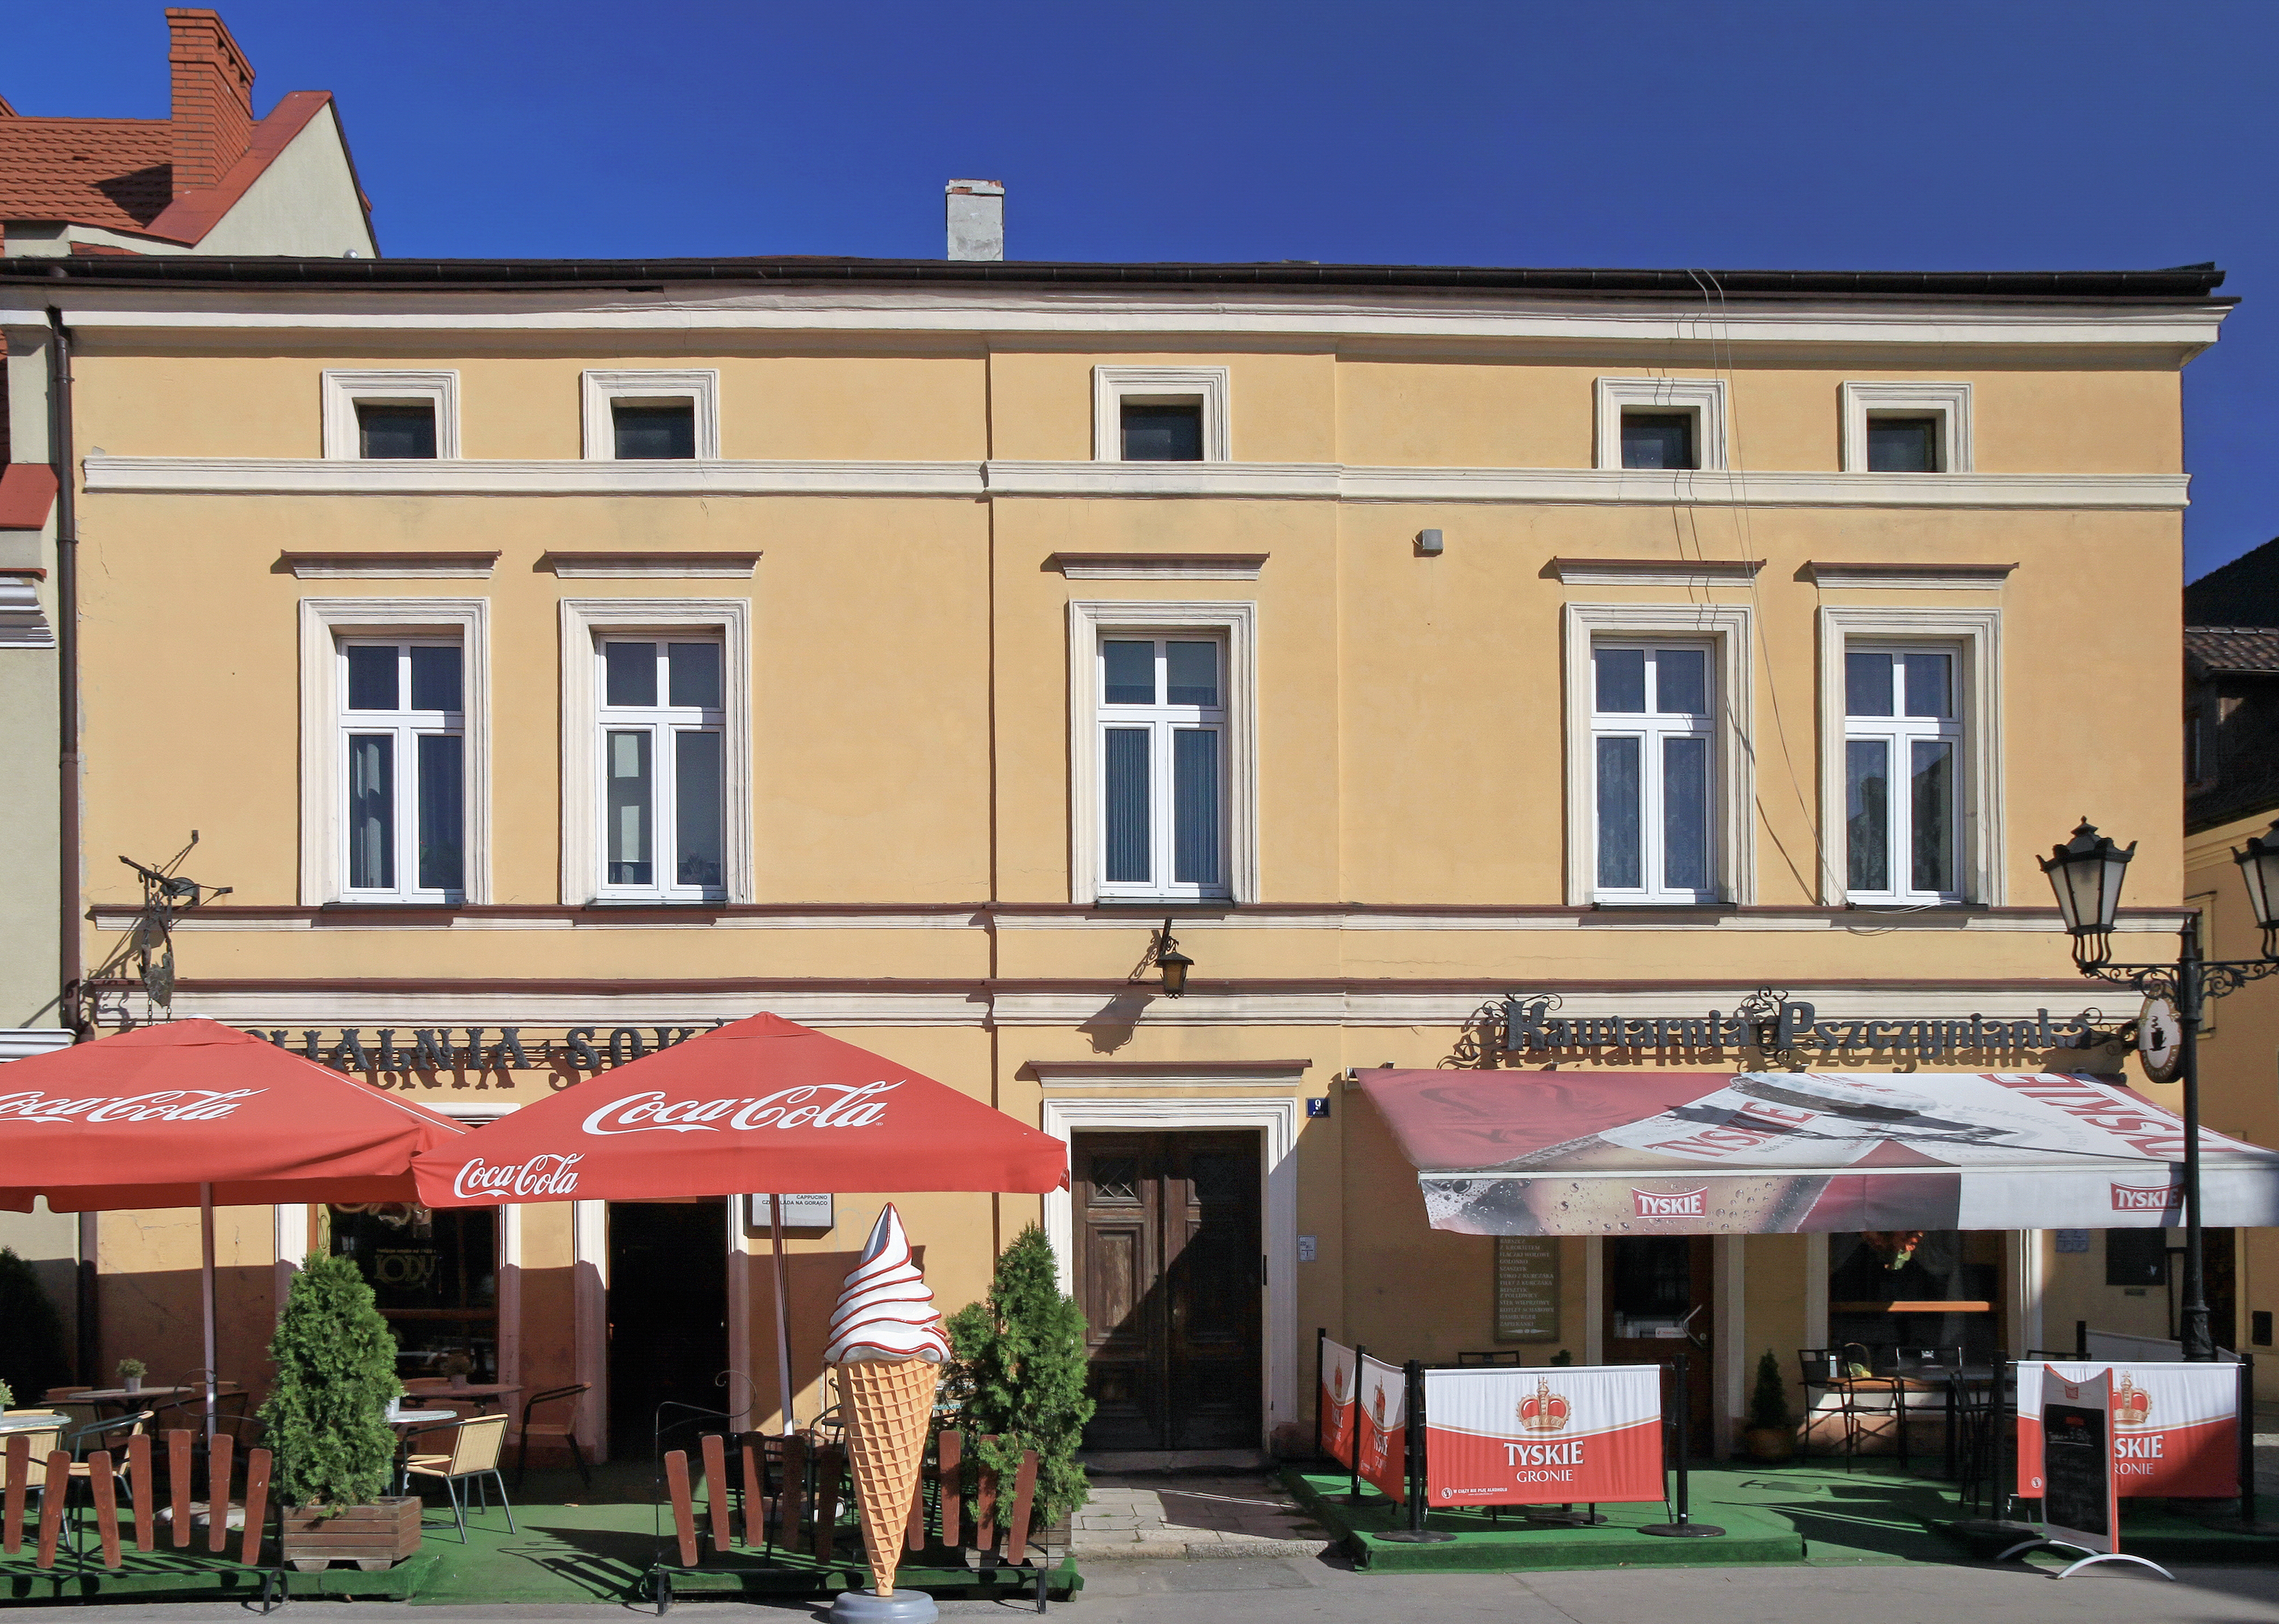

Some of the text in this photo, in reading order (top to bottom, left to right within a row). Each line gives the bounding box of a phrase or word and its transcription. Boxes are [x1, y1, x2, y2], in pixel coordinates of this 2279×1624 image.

[1505, 1000, 2093, 1060] Kawiarnia Pszczynianka
[582, 1079, 906, 1135] Coca-Cola
[1315, 1099, 1321, 1110] 9
[1643, 1101, 1816, 1158] TYSKIE
[454, 1152, 585, 1198] Coca-Cola
[1637, 1194, 1703, 1214] TYSKIE
[2115, 1188, 2179, 1208] TYSKIE
[1503, 1440, 1584, 1466] TYSKIE
[2114, 1434, 2164, 1458] SKIE
[1516, 1469, 1573, 1483] GRONIE
[2114, 1463, 2154, 1475] RONIE
